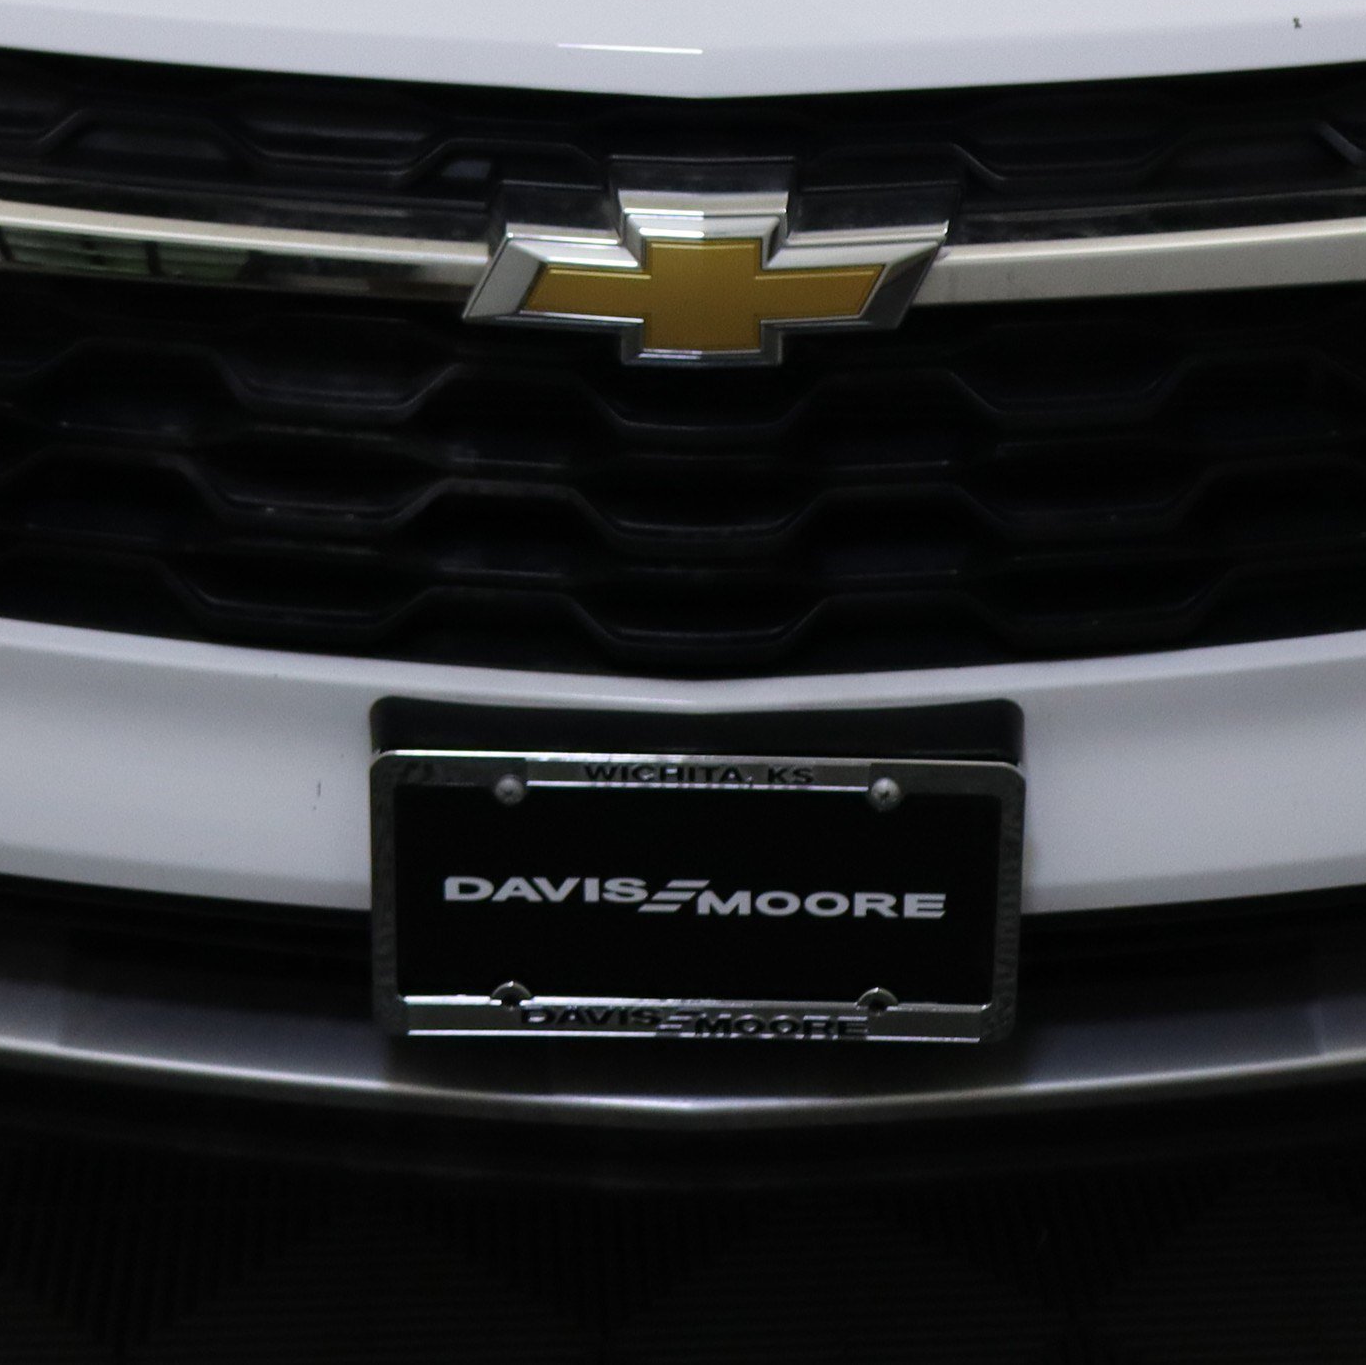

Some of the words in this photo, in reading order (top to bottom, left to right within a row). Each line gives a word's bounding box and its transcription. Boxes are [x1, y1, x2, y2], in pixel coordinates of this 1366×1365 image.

[766, 766, 816, 785] KS
[443, 875, 649, 904] DAVIS
[696, 890, 948, 919] MOORE
[520, 1005, 661, 1027] DAVIS
[695, 1013, 870, 1039] MOORE
